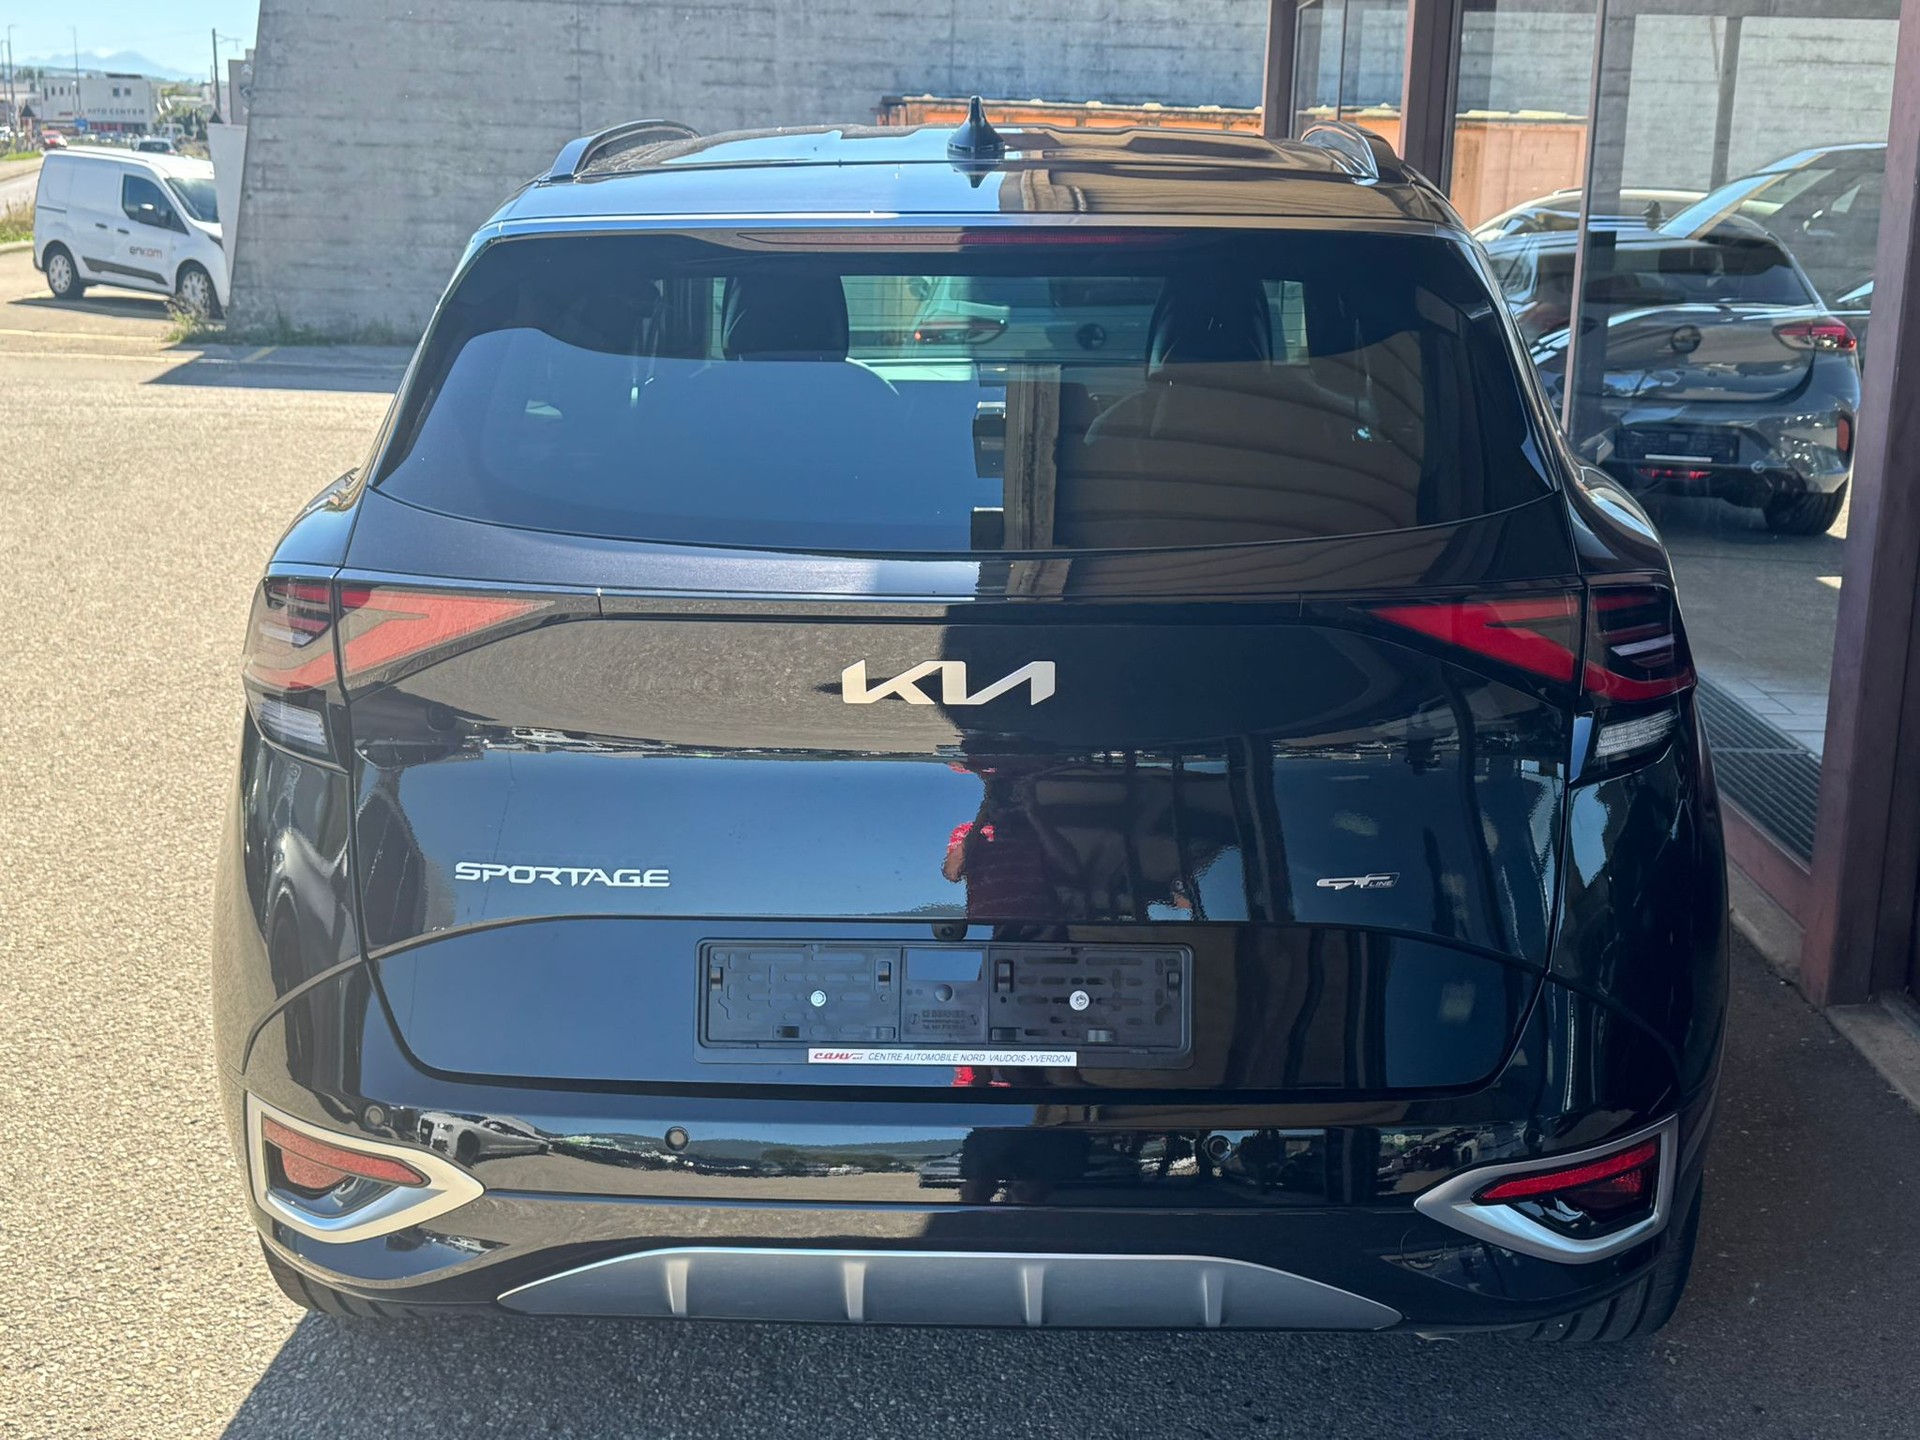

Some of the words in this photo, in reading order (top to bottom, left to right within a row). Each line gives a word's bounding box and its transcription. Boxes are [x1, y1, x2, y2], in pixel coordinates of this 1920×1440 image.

[841, 659, 1056, 706] KIA
[455, 861, 671, 887] SPORTAGE
[868, 1052, 902, 1061] CENTRE
[903, 1052, 959, 1062] AUTOMOBILE
[960, 1053, 986, 1062] NORD
